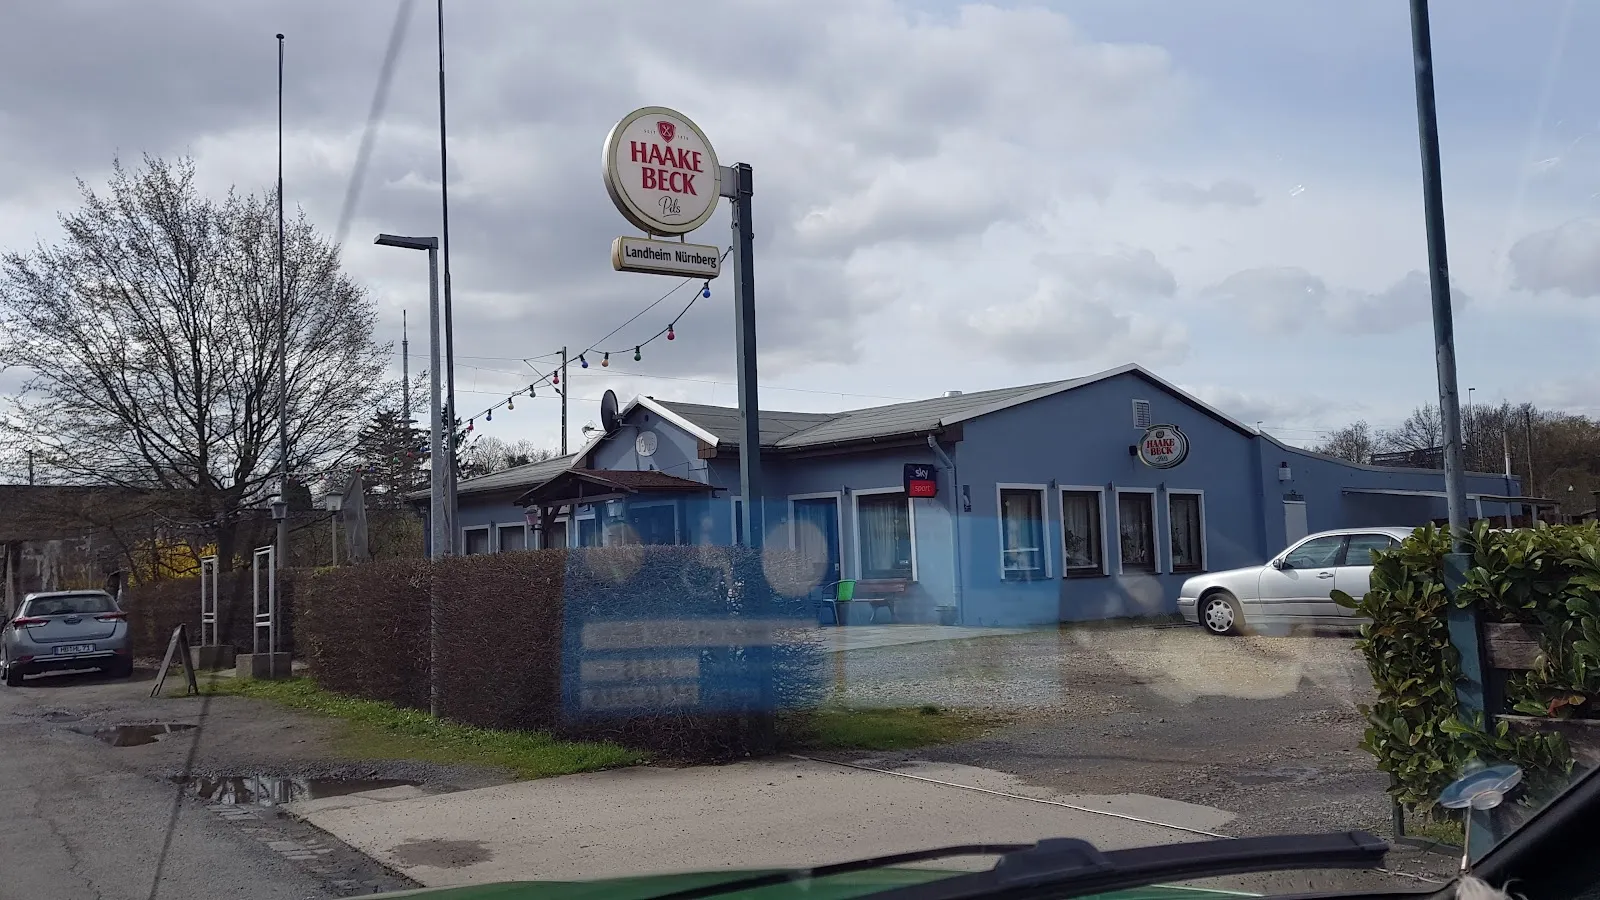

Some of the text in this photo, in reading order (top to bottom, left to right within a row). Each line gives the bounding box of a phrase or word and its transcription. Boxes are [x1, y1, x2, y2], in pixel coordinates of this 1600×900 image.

[630, 140, 704, 173] HAAKE
[641, 166, 698, 196] BECK
[658, 195, 681, 215] Pils
[625, 245, 717, 269] Landheim Nürnberg
[1146, 438, 1175, 448] HAAKE
[1150, 446, 1173, 456] BECK
[915, 467, 929, 480] sky
[914, 485, 931, 493] sport
